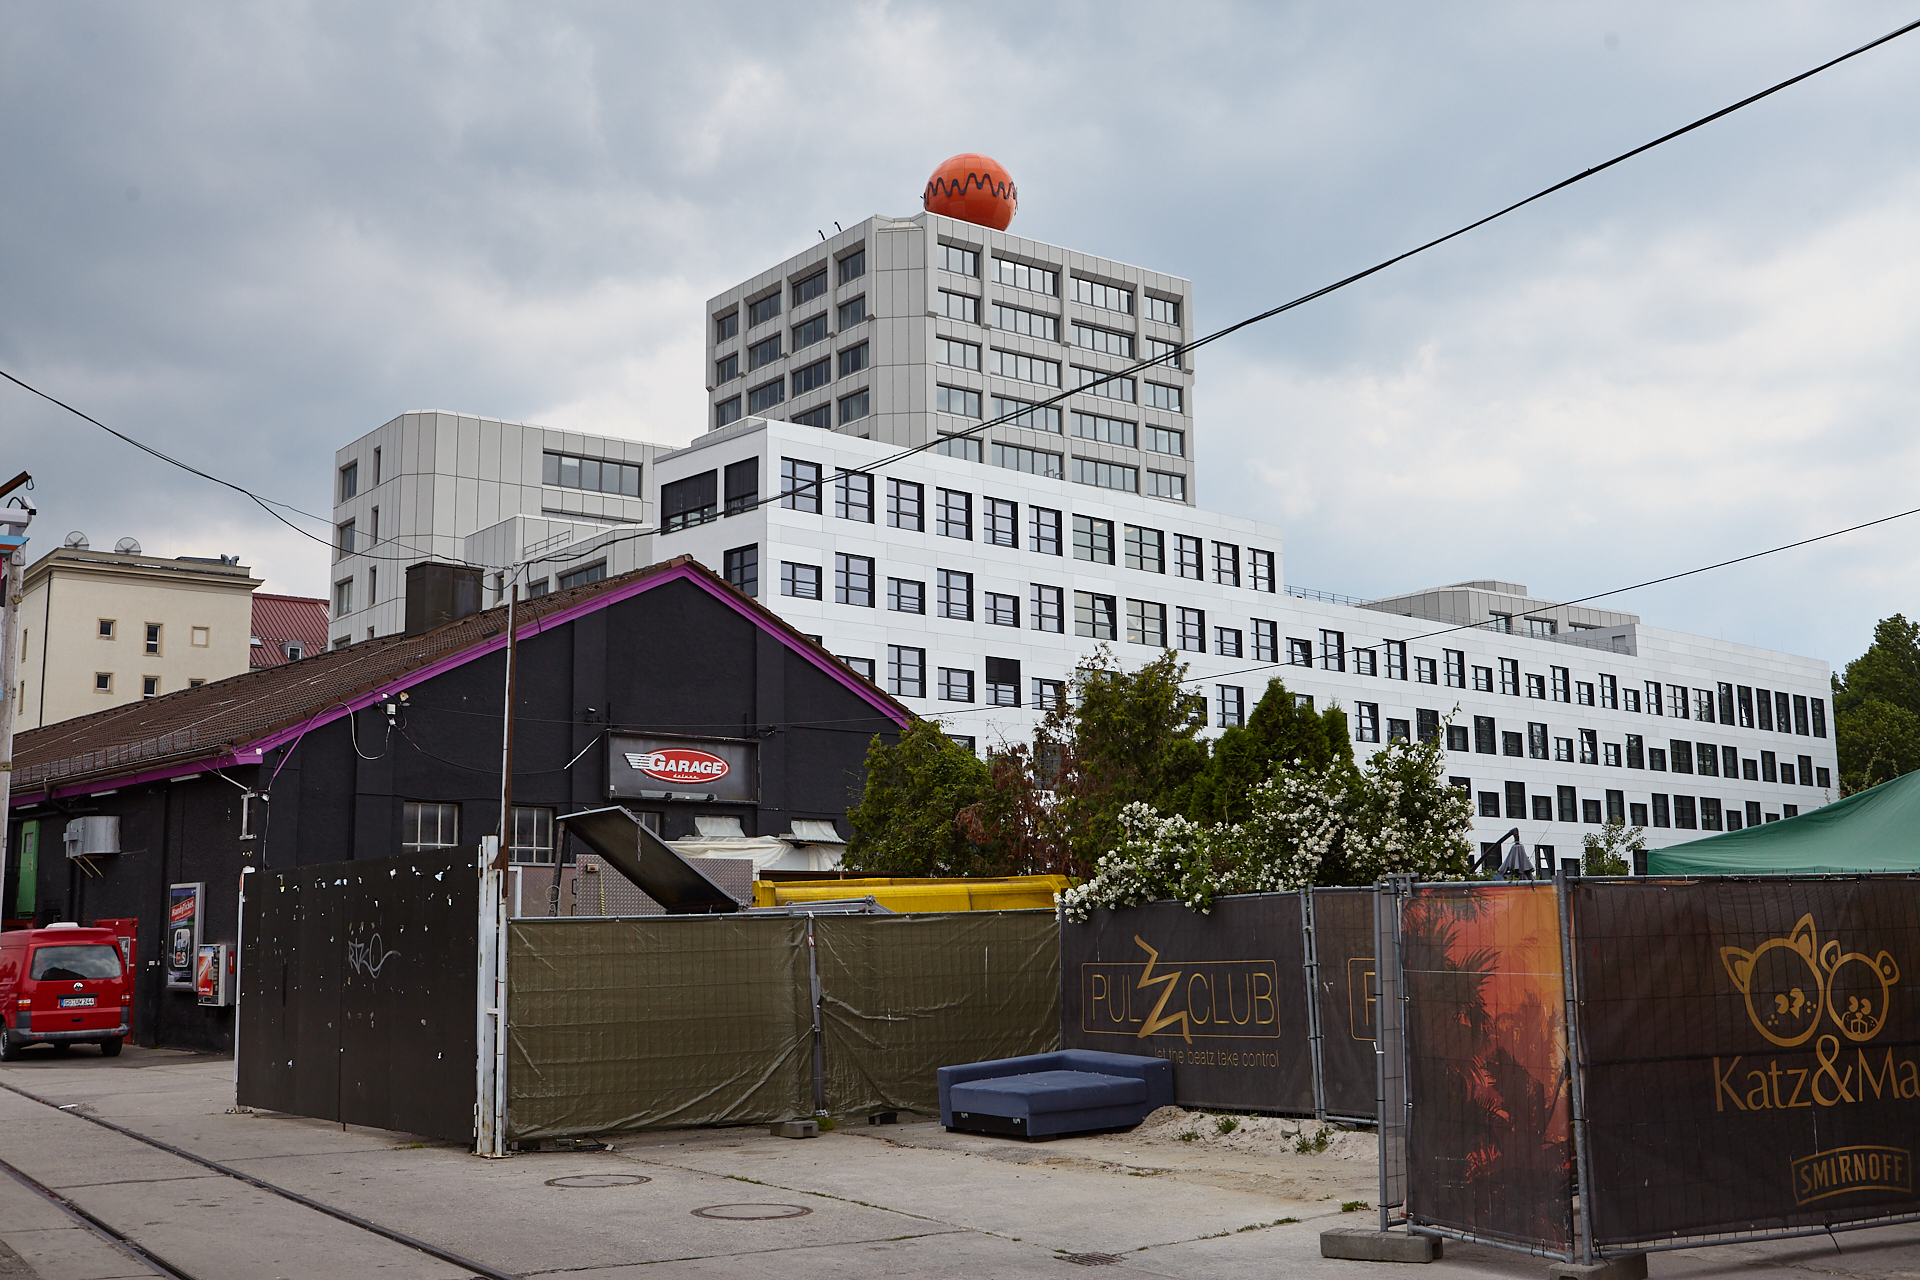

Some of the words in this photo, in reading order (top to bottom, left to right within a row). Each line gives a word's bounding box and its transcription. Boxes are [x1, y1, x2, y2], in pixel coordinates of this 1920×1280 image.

[649, 754, 722, 774] GARAGE
[1188, 972, 1275, 1025] CLUB
[1168, 1047, 1184, 1064] the
[1187, 1048, 1215, 1066] beatz
[1217, 1049, 1239, 1067] take
[1242, 1050, 1279, 1068] control
[1800, 1153, 1903, 1195] SMIRNOFF
